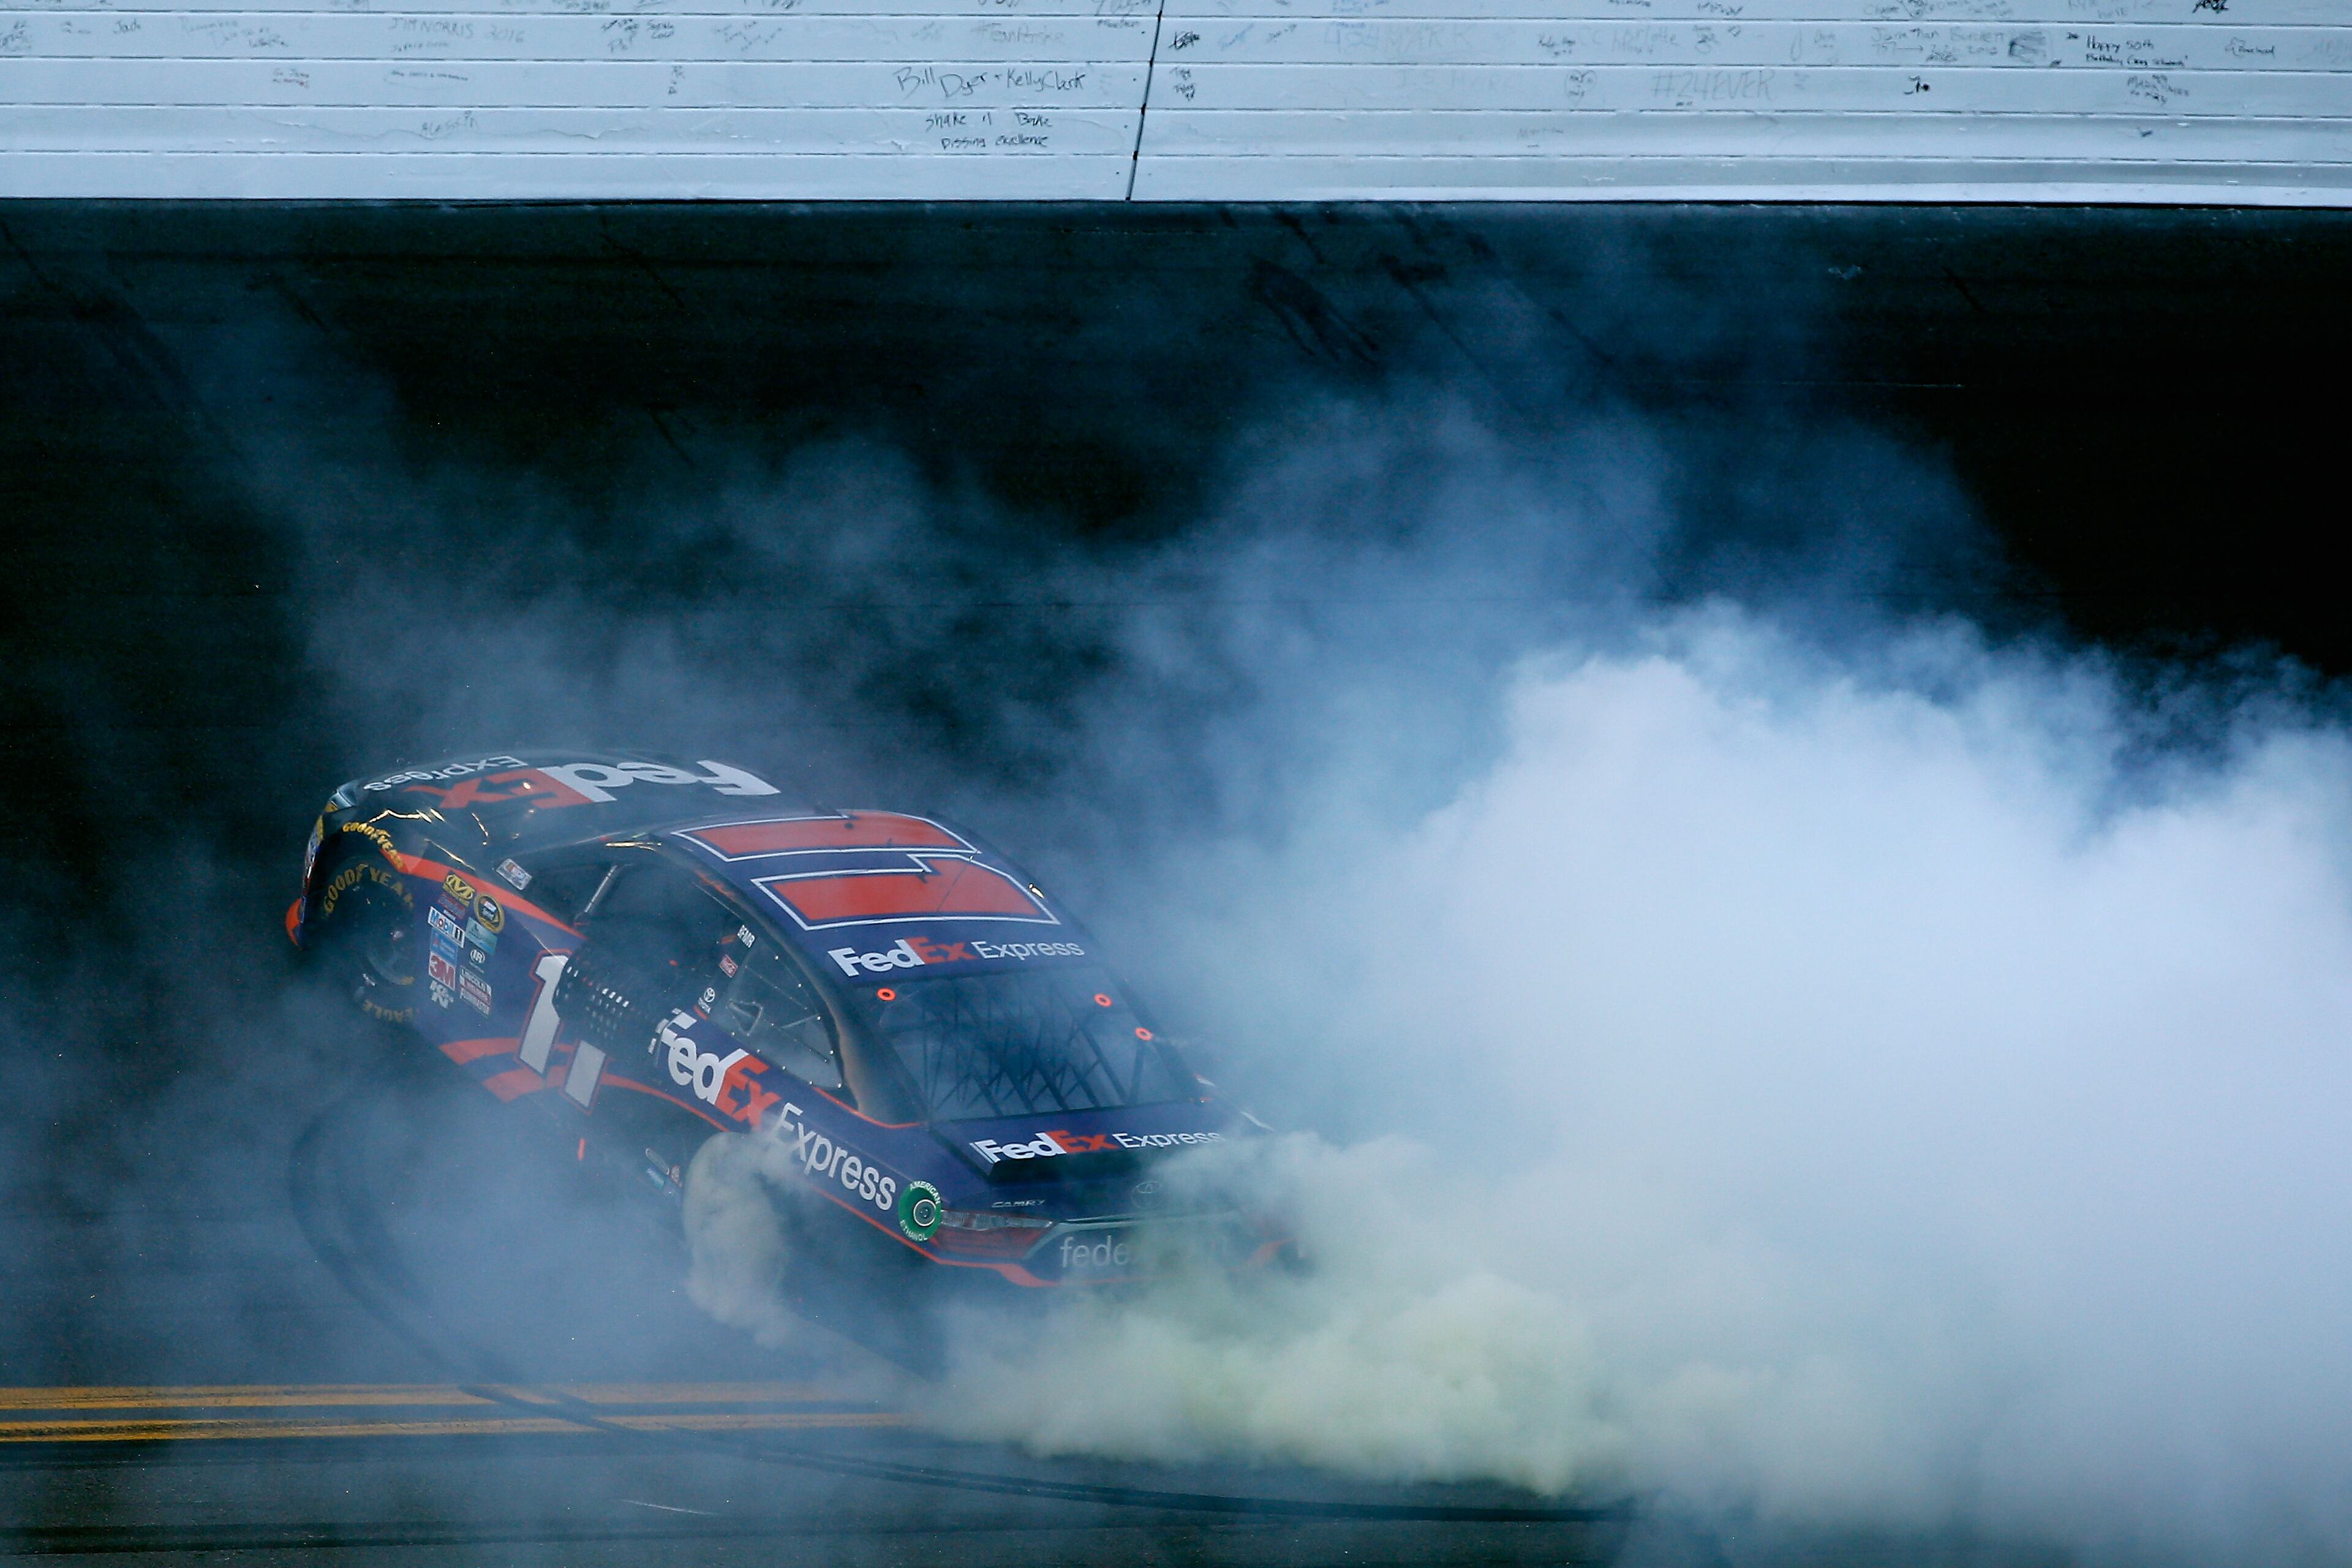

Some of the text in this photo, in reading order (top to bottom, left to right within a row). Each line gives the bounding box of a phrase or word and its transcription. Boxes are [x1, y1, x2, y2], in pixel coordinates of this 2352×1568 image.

[892, 66, 935, 99] Bill
[363, 755, 782, 809] FedEx Express
[827, 936, 1085, 978] FedEx Express
[652, 1008, 897, 1212] FedEx Express
[970, 1130, 1227, 1164] FedEx Express
[910, 1180, 941, 1205] AMERICAN
[991, 1199, 1046, 1208] CAMRY
[899, 1219, 928, 1242] ETHANOL
[1060, 1234, 1133, 1268] fede
